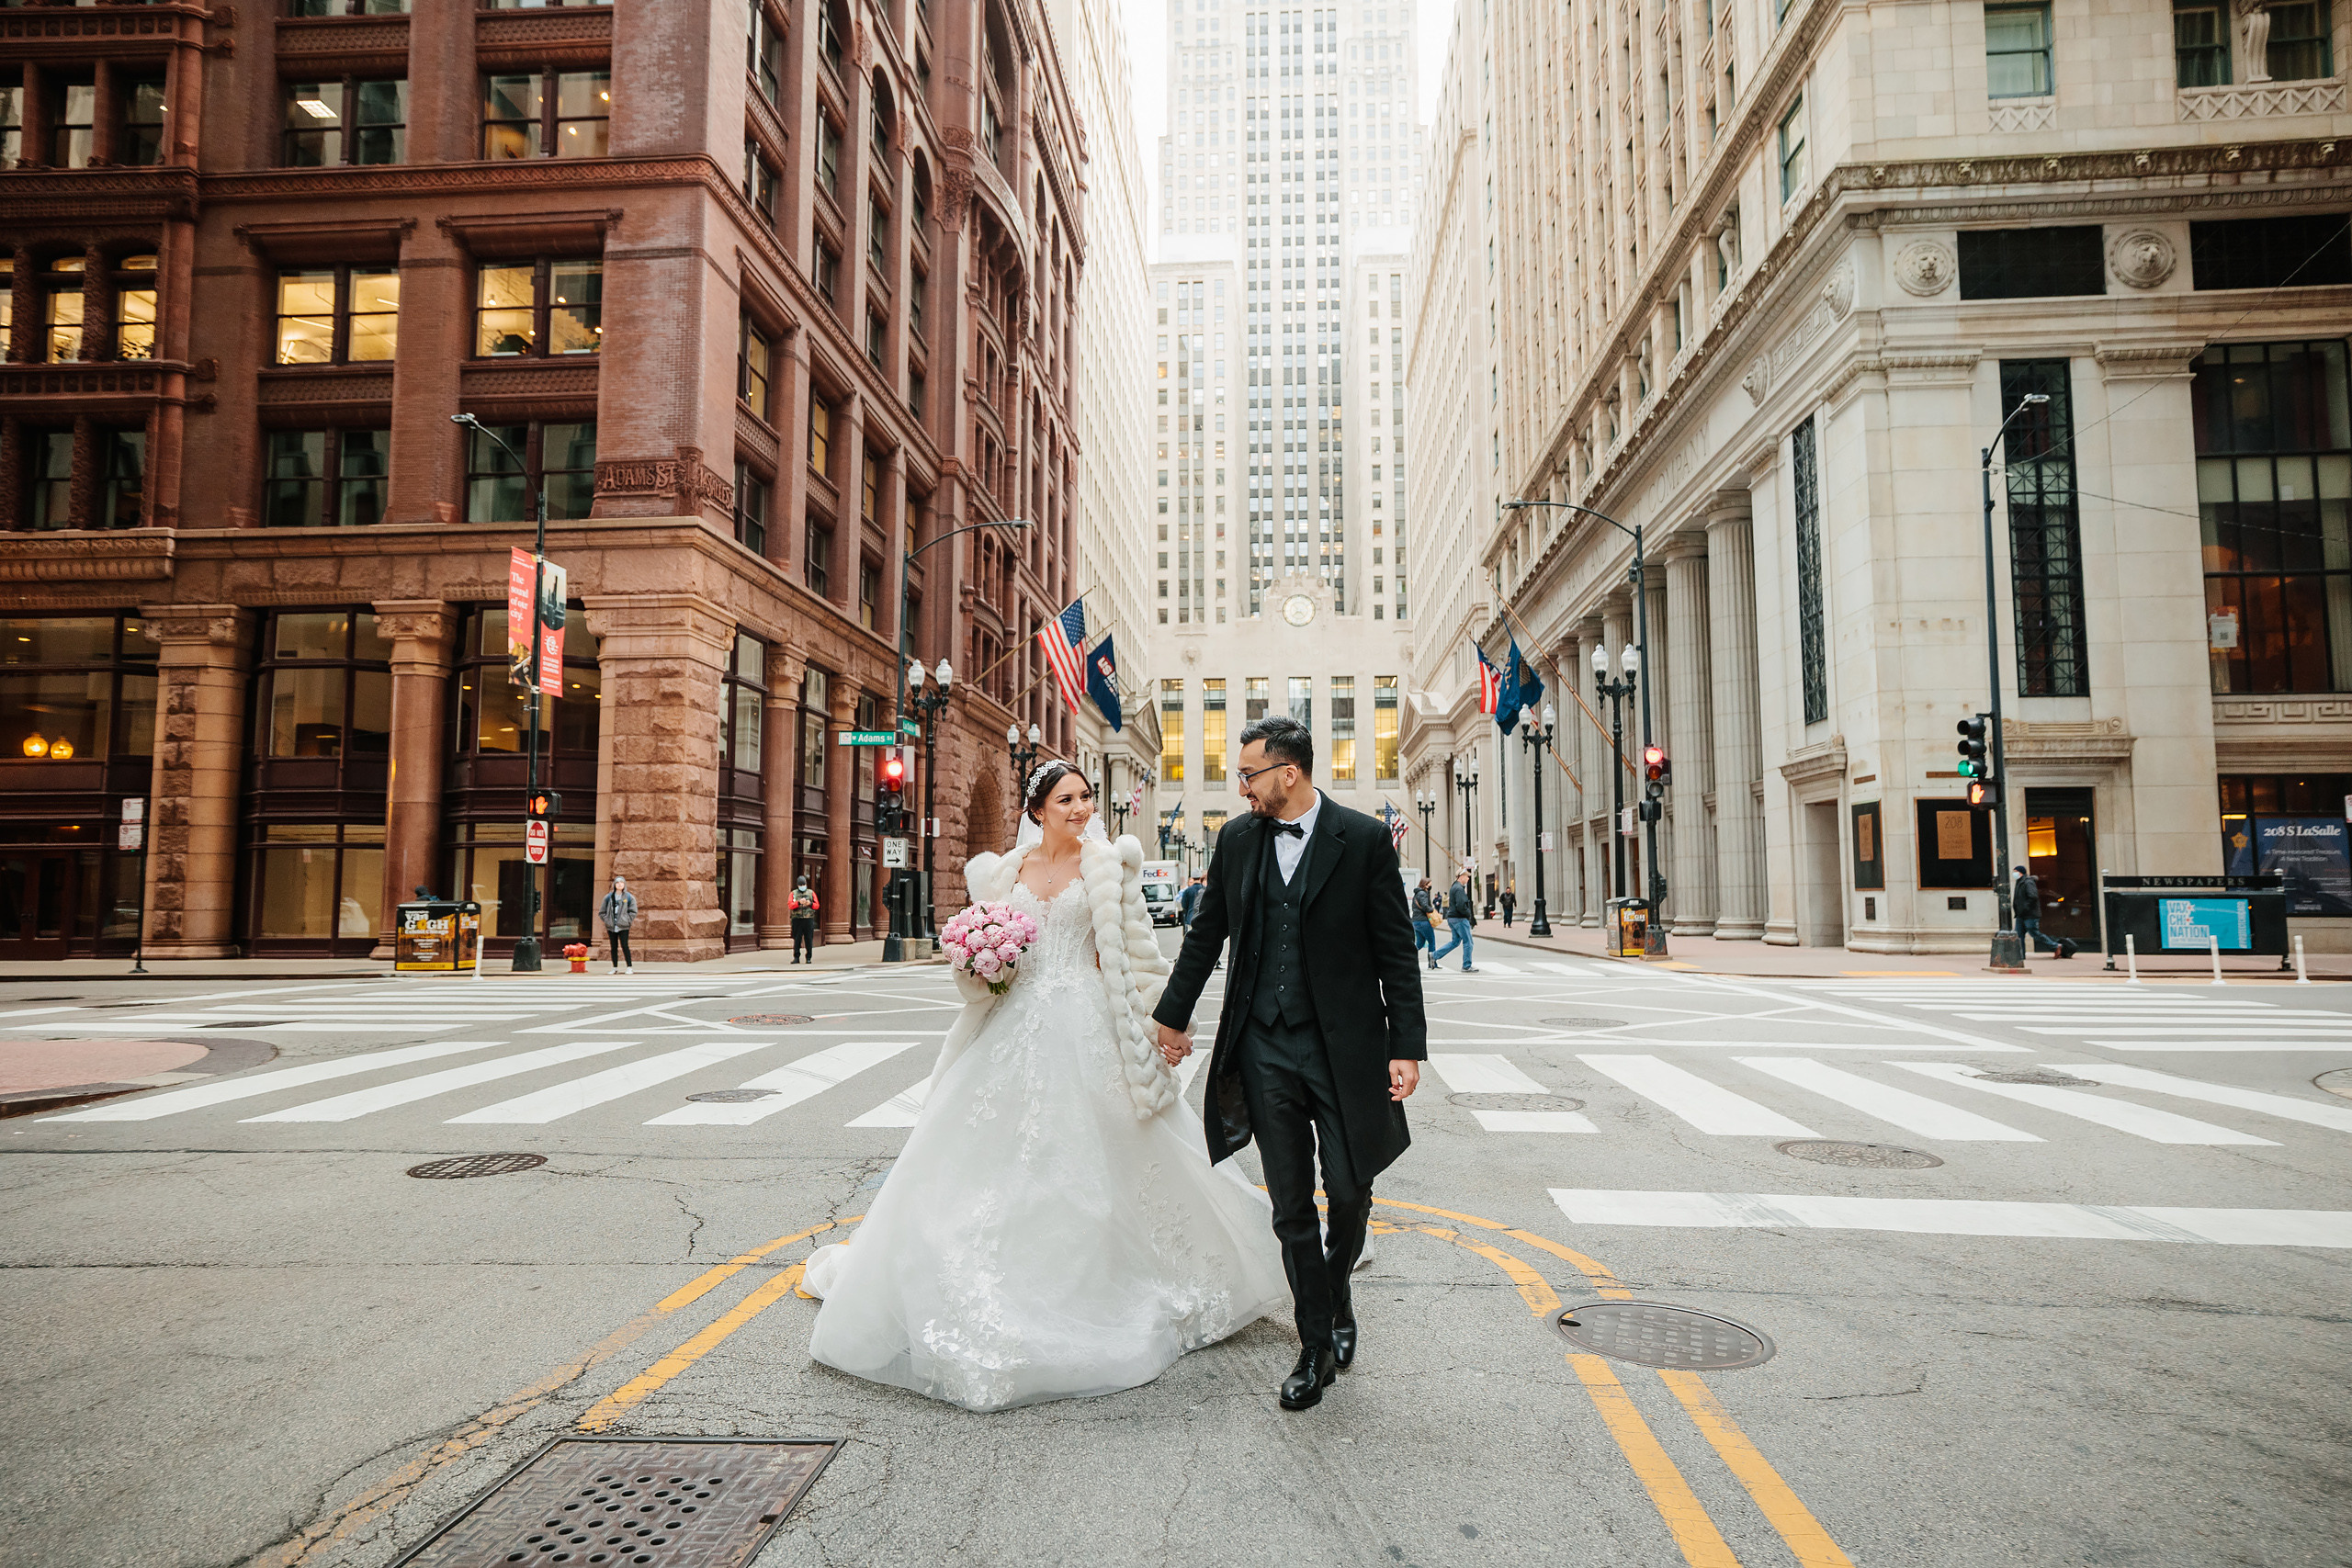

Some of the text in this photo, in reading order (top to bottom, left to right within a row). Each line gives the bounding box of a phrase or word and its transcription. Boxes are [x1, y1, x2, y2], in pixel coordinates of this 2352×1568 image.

[603, 462, 678, 491] ADAMS ST
[1591, 538, 1607, 573] AND
[1648, 422, 1709, 513] COMPANY
[511, 571, 525, 585] The
[510, 586, 529, 599] sound
[857, 734, 886, 743] Adams
[1944, 816, 1963, 829] 208
[2263, 825, 2342, 837] 208 S LaSalle
[1143, 869, 1169, 878] FedEx
[2142, 877, 2246, 886] NEWSPAPERS
[2169, 902, 2189, 913] VAX
[2170, 926, 2208, 938] NATION
